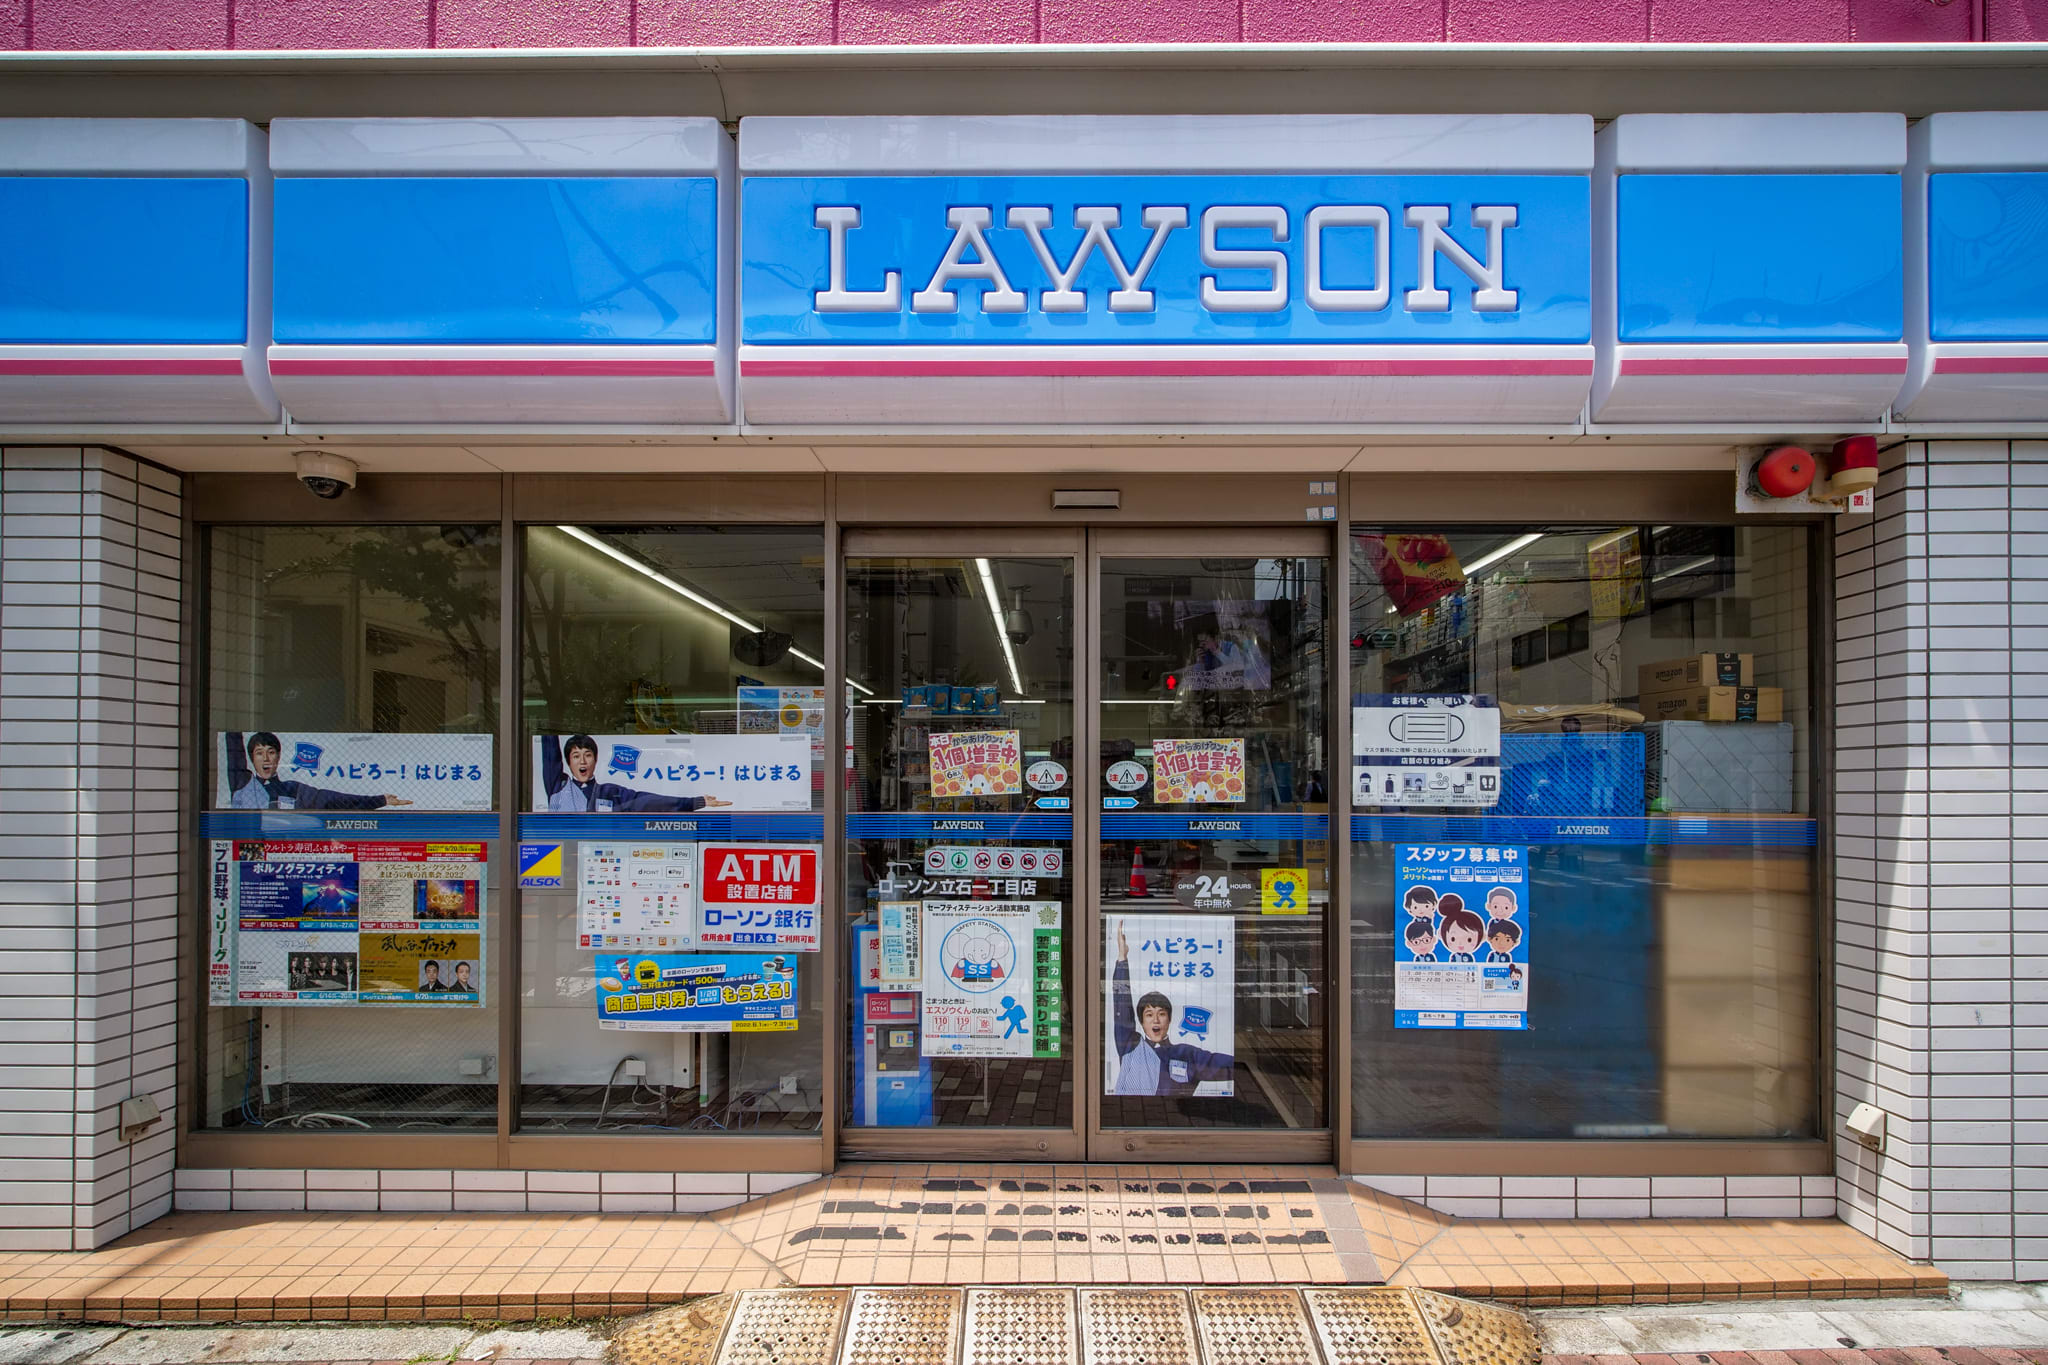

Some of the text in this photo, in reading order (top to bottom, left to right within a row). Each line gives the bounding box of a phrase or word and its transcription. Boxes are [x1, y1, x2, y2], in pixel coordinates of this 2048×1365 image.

[812, 204, 1519, 312] LAWSON
[1655, 667, 1683, 679] amazon
[1656, 698, 1688, 710] amazon
[930, 735, 950, 746] 本日
[1153, 741, 1173, 753] 本日
[325, 762, 482, 781] ハピろー! はじまる
[643, 764, 801, 781] ハピろー! はじまる
[326, 820, 378, 830] LAWSON
[645, 821, 697, 831] LAWSON
[932, 820, 985, 830] LAWSON
[1188, 821, 1241, 831] LAWSON
[1556, 825, 1610, 836] LAWSON
[264, 843, 356, 854] ウルトラ寿司ふぁいやー
[1407, 847, 1518, 863] スタッフ募集中
[253, 863, 345, 875] ポルノグラフィティ
[376, 863, 468, 871] ディズニー・オン・クラシック
[716, 853, 801, 882] ATM
[445, 871, 465, 879] 2022
[520, 877, 561, 887] ALSOK
[878, 878, 1037, 896] ローソン立石一丁目店
[1195, 875, 1230, 898] 24
[727, 883, 793, 900] 設置店舗
[214, 847, 230, 962] プロ野球・Jリーグ
[926, 904, 1031, 913] セーフティステーション活動実施店
[1193, 898, 1232, 908] 年中無休
[705, 909, 814, 928] ローソン銀行
[955, 921, 1001, 933] SAFETY STATION
[701, 933, 816, 944] 信用金庫 出金 入金 ご利用可能
[1141, 937, 1223, 955] ハピろー!
[967, 964, 989, 975] SS
[1148, 961, 1214, 978] はじまる
[723, 982, 791, 1003] もらえる!
[1036, 935, 1049, 1051] 警察官立寄り店舗
[1050, 935, 1060, 1052] 防犯カメラ設置店
[934, 1017, 970, 1025] 110 119
